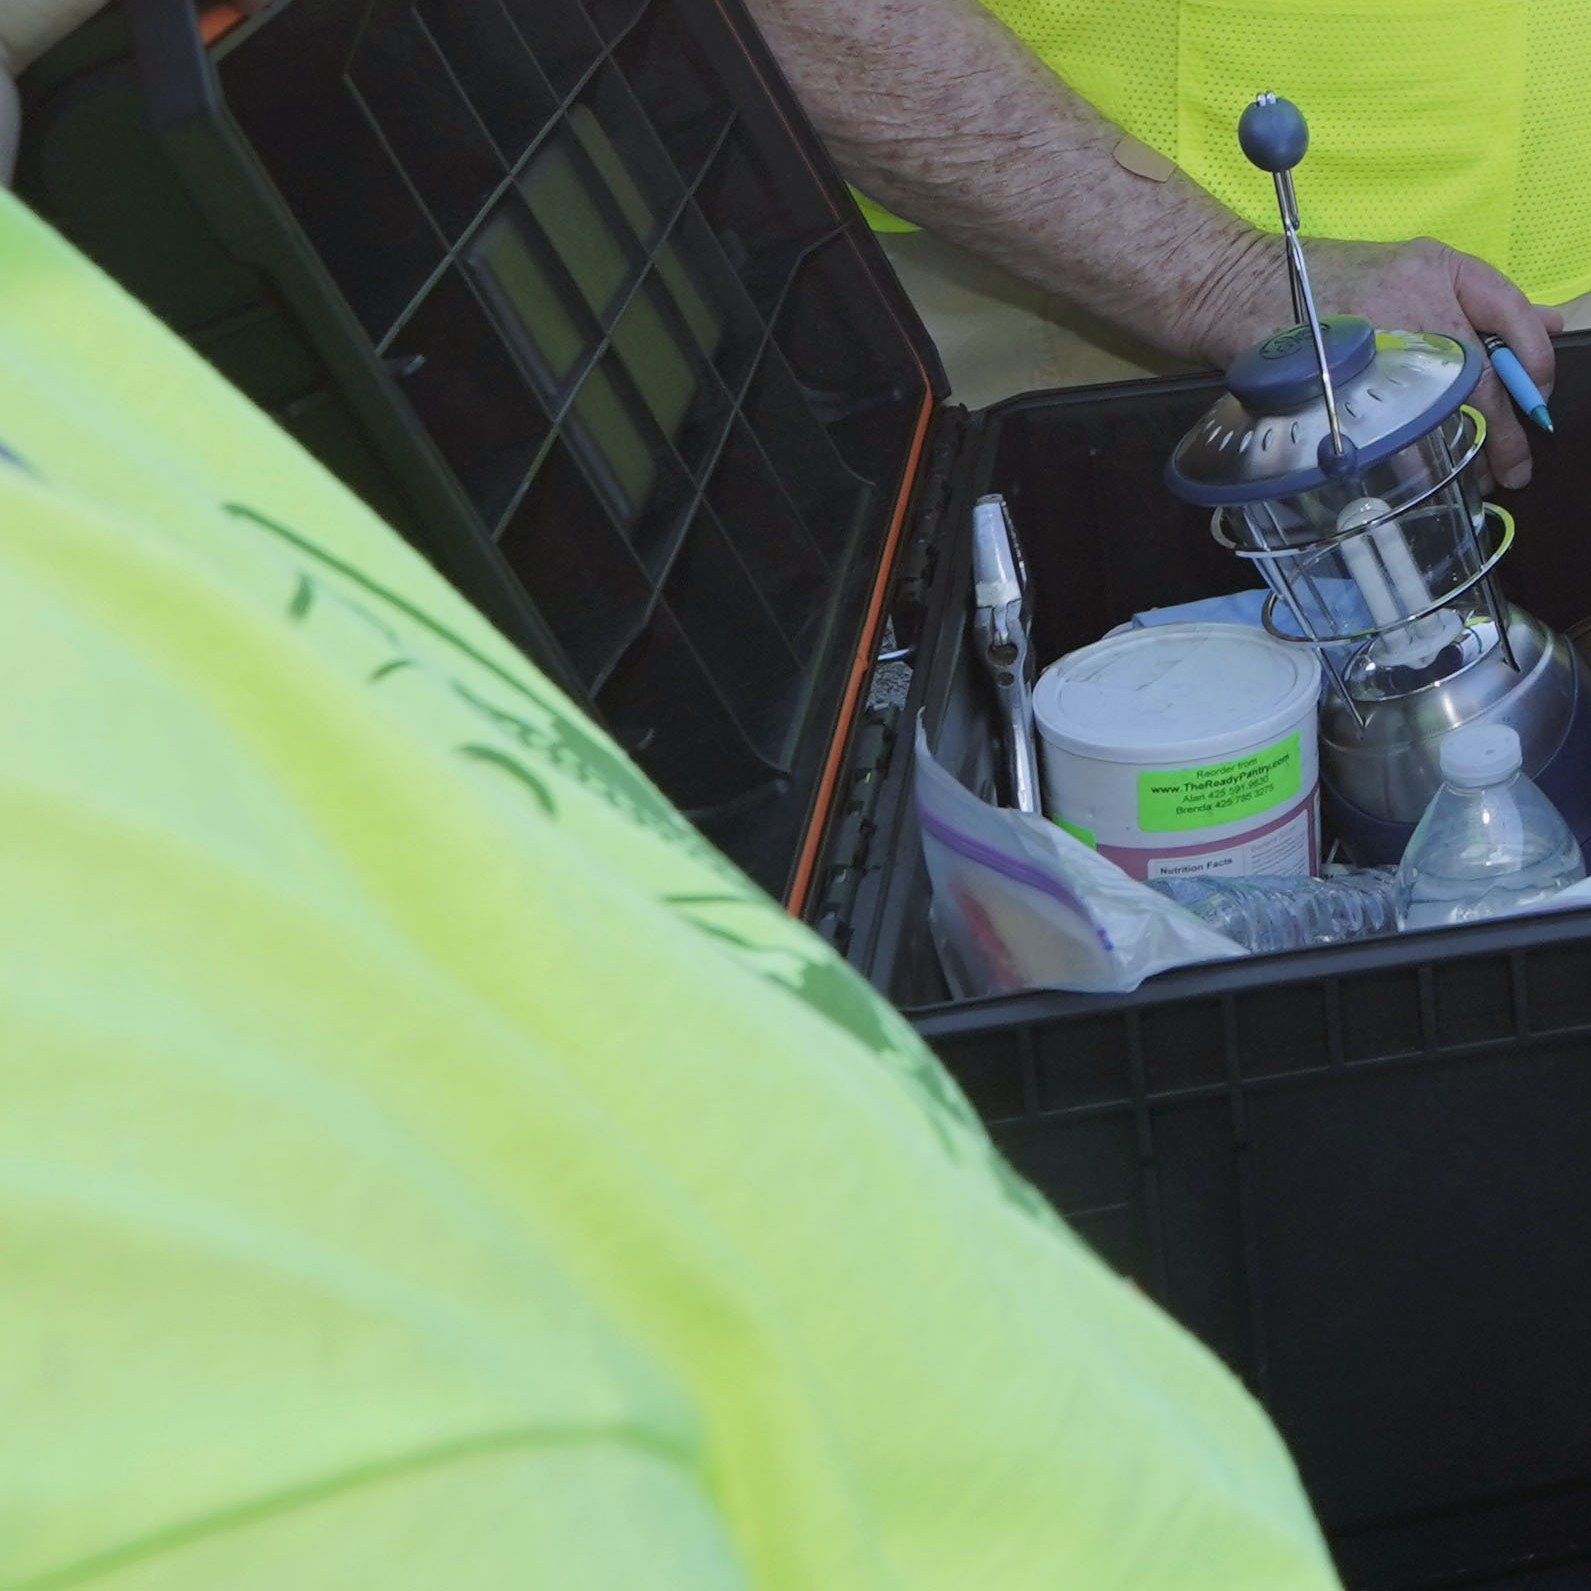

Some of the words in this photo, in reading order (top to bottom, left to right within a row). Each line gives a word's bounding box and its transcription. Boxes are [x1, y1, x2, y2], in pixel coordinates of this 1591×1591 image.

[1151, 753, 1291, 794] www.TheReadyPantry.com
[1196, 764, 1234, 779] Reorder
[1237, 757, 1259, 770] from
[1182, 793, 1206, 804] Alan
[1207, 789, 1226, 800] 425
[1176, 802, 1213, 816] Brenda
[1215, 797, 1233, 809] 425
[1159, 862, 1204, 875] Nutrition
[1206, 857, 1233, 870] Facts
